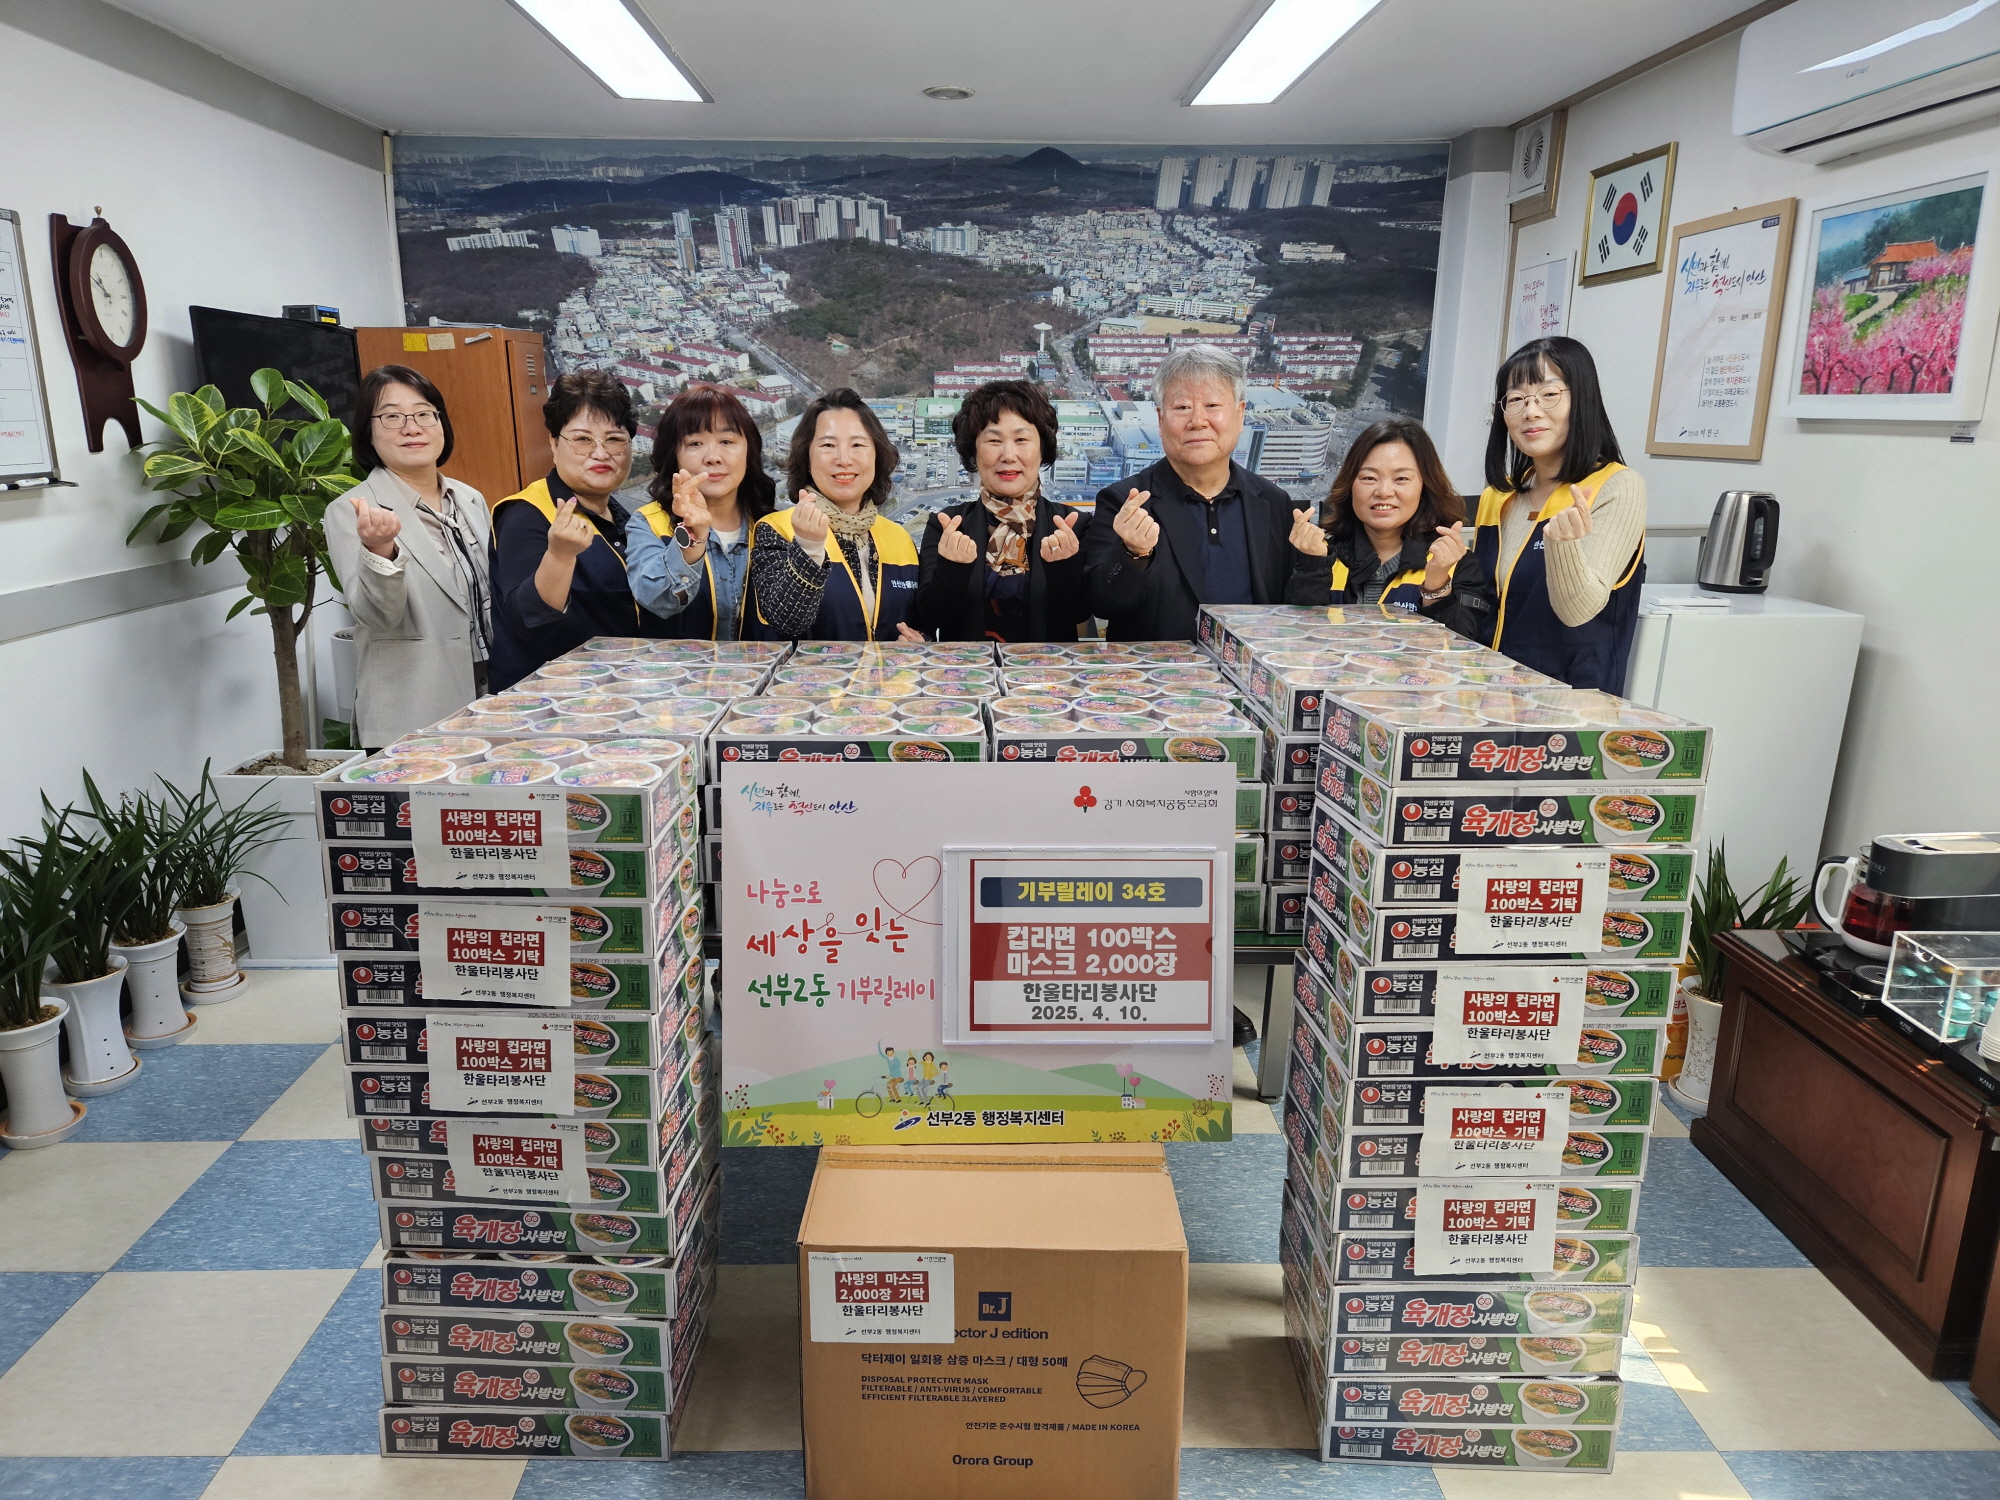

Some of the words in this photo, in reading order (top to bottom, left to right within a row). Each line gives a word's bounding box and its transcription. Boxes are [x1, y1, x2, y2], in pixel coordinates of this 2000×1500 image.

[1431, 741, 1461, 755] 농심
[1469, 740, 1547, 774] 육개장
[1545, 755, 1594, 772] 사발면
[741, 782, 775, 802] 시민과
[776, 783, 801, 798] 함께,
[752, 801, 785, 817] 자유로운
[788, 801, 825, 816] 혁신도시
[828, 801, 858, 813] 안산
[1104, 799, 1122, 810] 경기
[1125, 799, 1217, 810] 사회복지공동모금회
[446, 811, 487, 826] 사랑의
[495, 811, 536, 827] 컵라면
[1423, 806, 1454, 820] 농심
[1461, 804, 1538, 838] 육개장
[1535, 819, 1586, 835] 사발면
[447, 829, 502, 843] 100박스
[509, 830, 536, 844] 기탁
[450, 847, 538, 860] 한울타리봉사단
[498, 873, 536, 881] 행정복지센터
[746, 877, 822, 909] 나눔으로
[1017, 881, 1114, 902] 기부릴레이
[1121, 881, 1166, 902] 34호
[1491, 879, 1532, 894] 사랑의
[1538, 879, 1578, 894] 컵라면
[1490, 897, 1543, 911] 100박스
[1550, 896, 1578, 911] 기탁
[1490, 915, 1573, 929] 한울타리봉사단
[452, 930, 492, 944] 사랑의
[500, 932, 539, 947] 컵라면
[746, 917, 843, 964] 세상을
[855, 906, 909, 953] 잇는
[1006, 925, 1076, 951] 컵라면
[1087, 926, 1177, 950] 100박스
[1506, 940, 1528, 948] 선부2동
[1531, 940, 1567, 948] 행정복지센터
[453, 947, 505, 961] 100박스
[513, 950, 540, 964] 기탁
[1007, 952, 1077, 976] 마스크
[1085, 952, 1177, 976] 2,000장
[455, 964, 538, 981] 한울타리봉사단
[500, 991, 536, 1000] 행정복지센터
[747, 972, 831, 1008] 선부2동
[837, 974, 935, 1007] 기부릴레이
[1022, 982, 1158, 1003] 한울타리봉사단
[1468, 992, 1508, 1008] 사랑의
[1516, 993, 1555, 1008] 컵라면
[1031, 1005, 1084, 1021] 2025.
[1092, 1005, 1110, 1021] 4.
[1119, 1005, 1147, 1021] 10.
[1468, 1009, 1520, 1024] 100박스
[1528, 1009, 1554, 1024] 기탁
[1467, 1027, 1551, 1041] 한울타리봉사단
[460, 1039, 499, 1054] 사랑의
[507, 1040, 546, 1055] 컵라면
[461, 1056, 513, 1069] 100박스
[520, 1056, 546, 1070] 기탁
[1483, 1052, 1506, 1060] 선부2동
[1508, 1051, 1544, 1060] 행정복지센터
[463, 1072, 546, 1087] 한울타리봉사단
[926, 1110, 976, 1127] 선부2동
[981, 1110, 1065, 1127] 행정복지센터
[1456, 1109, 1496, 1124] 사랑의
[1502, 1109, 1541, 1124] 컵라면
[1455, 1125, 1507, 1138] 100박스
[1514, 1125, 1540, 1139] 기탁
[477, 1137, 514, 1151] 사랑의
[521, 1138, 557, 1153] 컵라면
[1454, 1140, 1535, 1150] 한울타리봉사단
[478, 1152, 527, 1166] 100박스
[534, 1155, 558, 1168] 기탁
[481, 1167, 559, 1181] 한울타리봉사단
[1448, 1200, 1487, 1214] 사랑의
[1494, 1200, 1531, 1214] 컵라면
[415, 1215, 444, 1227] 농심
[1448, 1216, 1498, 1229] 100박스
[1505, 1215, 1530, 1230] 기탁
[453, 1214, 523, 1243] 육개장
[521, 1229, 568, 1244] 사발면
[1449, 1232, 1528, 1245] 한울타리봉사단
[839, 1272, 878, 1285] 사랑의
[885, 1273, 924, 1285] 마스크
[450, 1271, 522, 1303] 육개장
[520, 1289, 565, 1303] 사발면
[839, 1288, 892, 1302] 2,000장
[899, 1288, 925, 1301] 기탁
[841, 1304, 924, 1317] 한울타리봉사단
[1402, 1298, 1476, 1328] 육개장
[1472, 1312, 1520, 1327] 사발면
[990, 1327, 998, 1339] J
[1002, 1327, 1049, 1340] edition
[861, 1353, 906, 1365] 닥터제이
[910, 1354, 943, 1365] 일회용
[947, 1354, 968, 1366] 삼중
[973, 1355, 1006, 1366] 마스크
[1009, 1356, 1013, 1367] /
[1017, 1356, 1039, 1367] 대형
[1042, 1357, 1068, 1368] 50매
[861, 1376, 905, 1384] DISPOSAL
[907, 1376, 962, 1385] PROTECTIVE
[964, 1377, 989, 1385] MASK
[861, 1385, 912, 1393] FILTERABLE
[920, 1386, 970, 1394] ANTI-VIRUS
[978, 1387, 1043, 1395] COMFORTABLE
[908, 1394, 960, 1402] FILTERABLE
[961, 1395, 1006, 1403] 3LAYERED
[1398, 1388, 1470, 1417] 육개장
[1467, 1402, 1514, 1416] 사발면
[448, 1419, 518, 1450] 육개장
[516, 1434, 562, 1449] 사발면
[966, 1422, 997, 1430] 안전기준
[1000, 1422, 1031, 1431] 준수시험
[1033, 1423, 1065, 1431] 합격제품
[1110, 1424, 1140, 1432] KOREA
[952, 1454, 990, 1466] Orora
[993, 1455, 1033, 1468] Group
